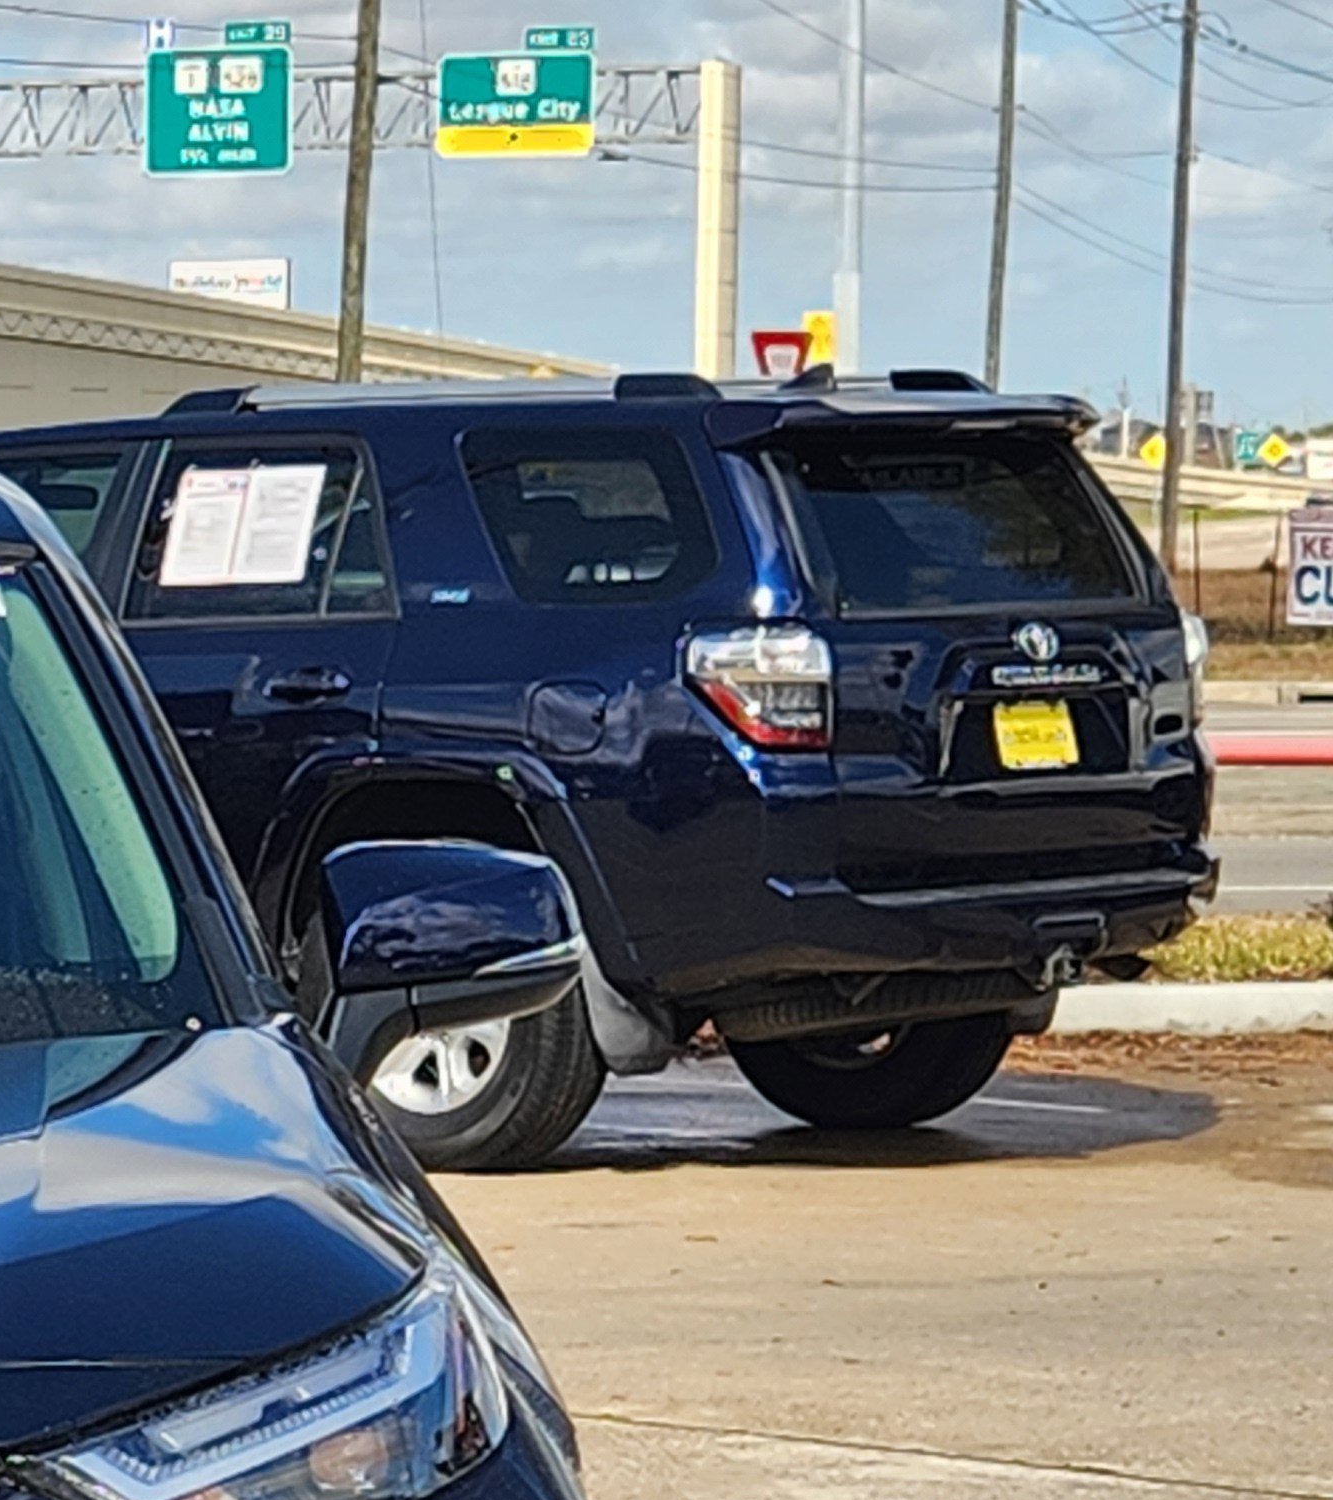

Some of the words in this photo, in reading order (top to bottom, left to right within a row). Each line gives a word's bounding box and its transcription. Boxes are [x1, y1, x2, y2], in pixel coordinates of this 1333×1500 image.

[188, 97, 245, 119] NASA
[537, 99, 581, 120] City
[188, 121, 249, 142] ALVIN
